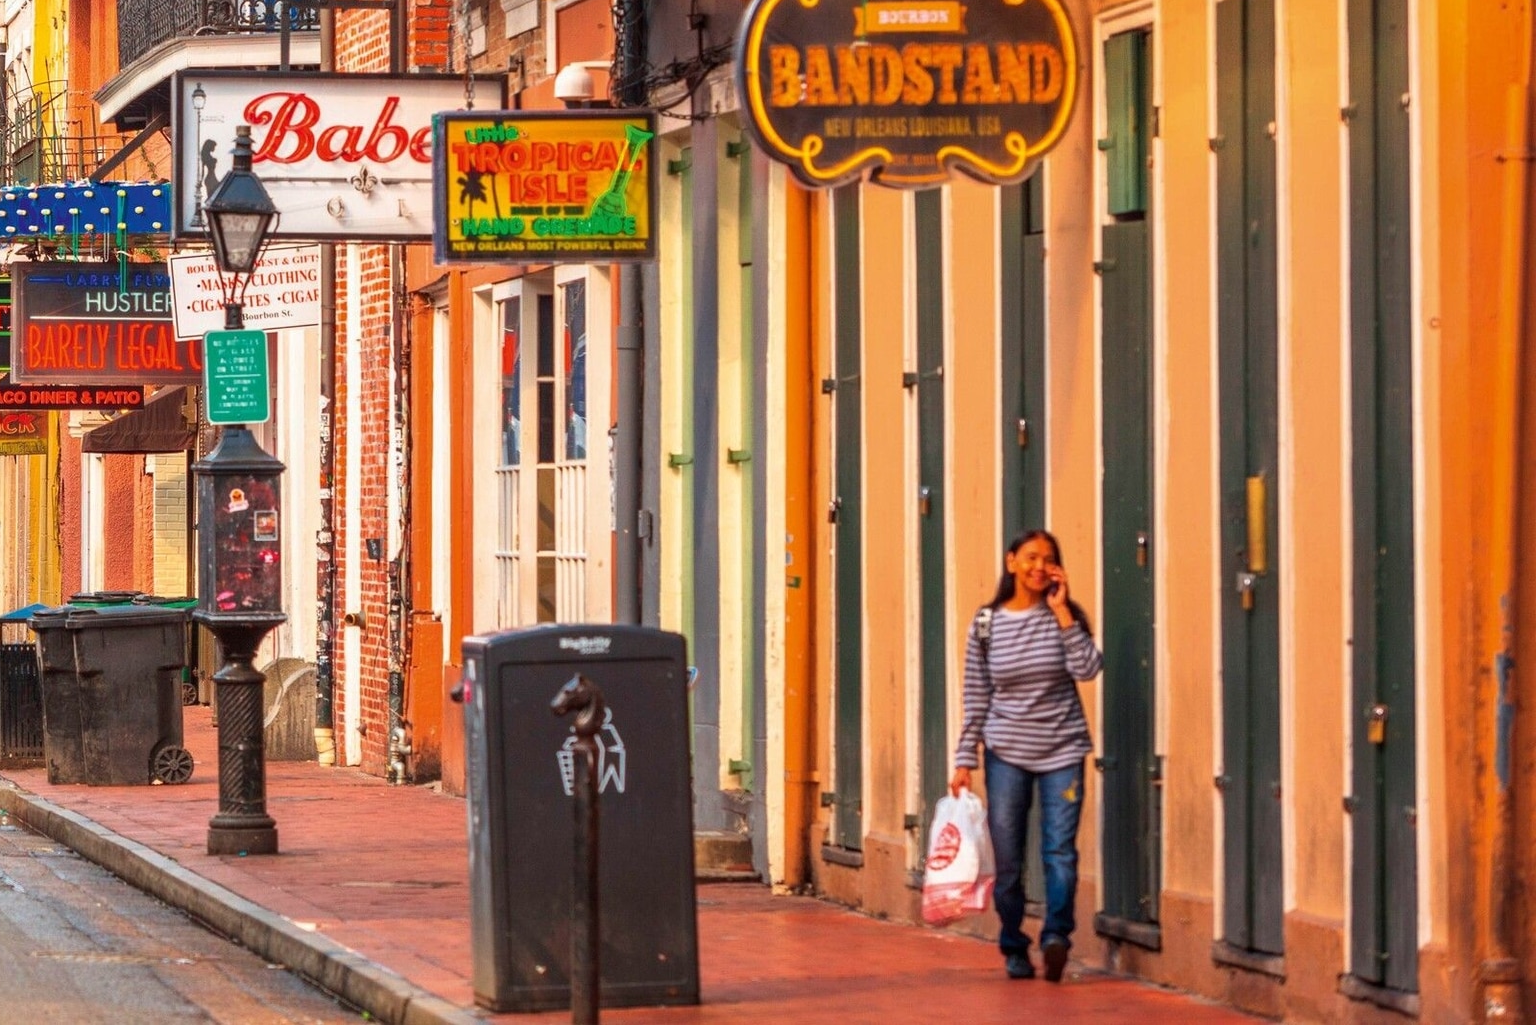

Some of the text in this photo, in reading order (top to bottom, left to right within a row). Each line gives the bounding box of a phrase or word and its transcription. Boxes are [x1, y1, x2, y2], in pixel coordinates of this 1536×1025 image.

[878, 10, 949, 24] BOURBON
[769, 41, 1062, 107] BANDSTAND
[824, 117, 851, 137] NEW
[855, 116, 908, 137] ORLEANS
[977, 115, 1001, 136] USA
[510, 174, 588, 203] ISLE
[461, 216, 637, 237] HAND GRENADE
[452, 240, 646, 251] NEW ORLEANS MOST POWERFUL DRINK
[282, 257, 289, 265] &
[65, 274, 122, 288] LARRY
[250, 269, 317, 287] CLOTHING
[242, 309, 293, 321] Bourbon St.
[28, 324, 109, 370] BARELY
[117, 322, 183, 371] LEGAL
[30, 390, 77, 405] DINER
[80, 390, 93, 405] &
[95, 390, 141, 405] PATIO
